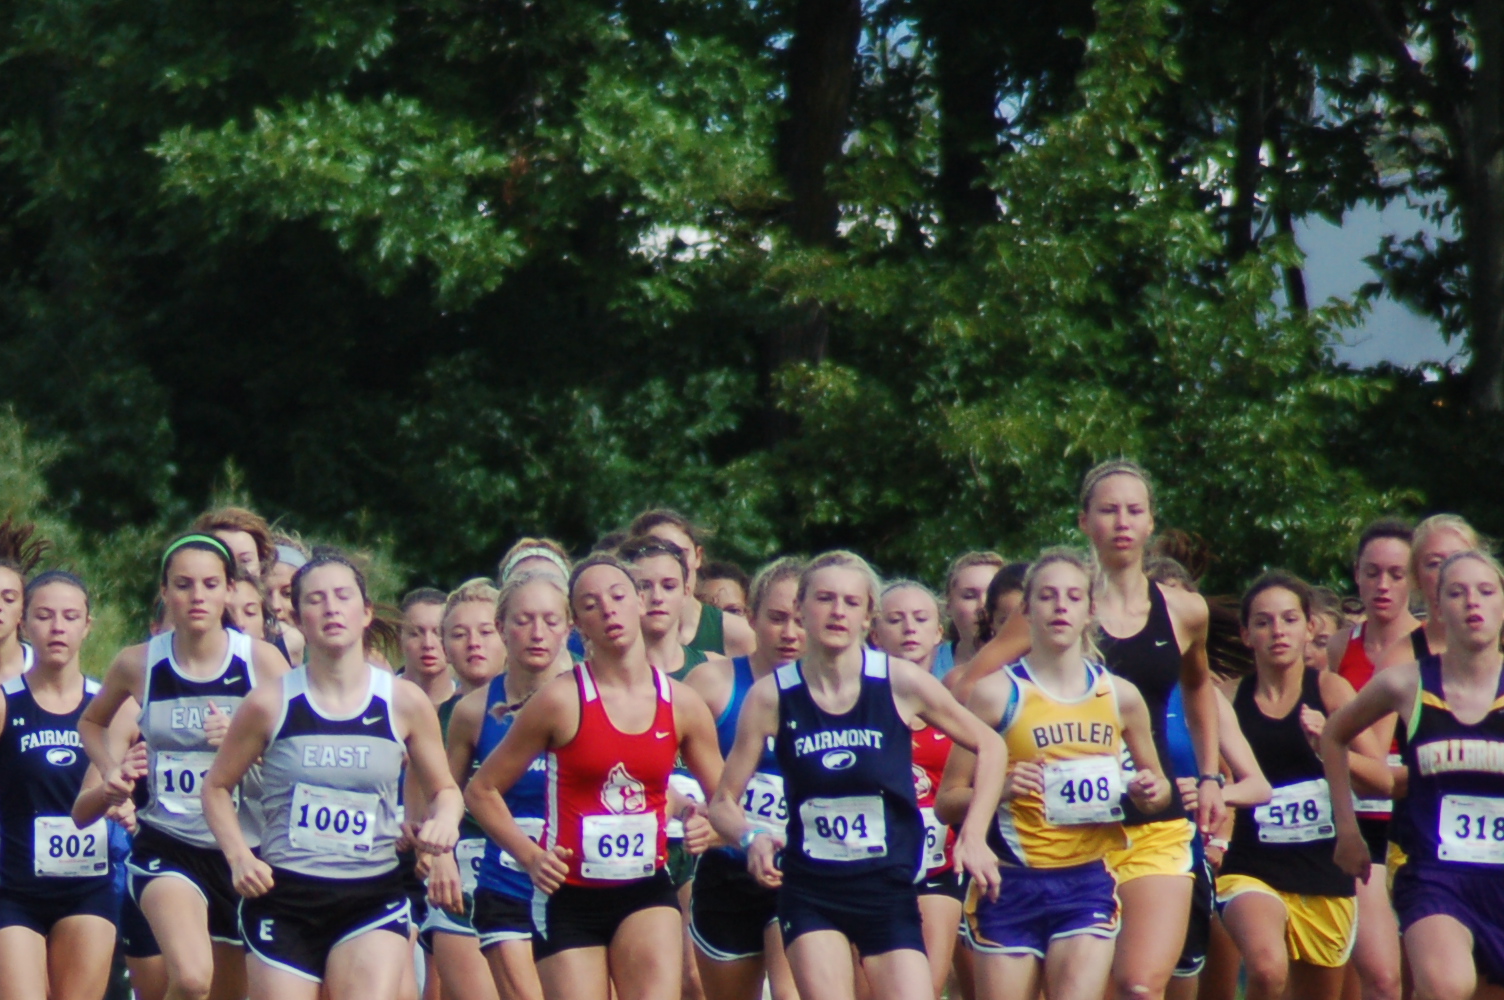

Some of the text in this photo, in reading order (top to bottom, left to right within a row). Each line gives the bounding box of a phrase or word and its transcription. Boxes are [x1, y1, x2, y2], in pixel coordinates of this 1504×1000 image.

[21, 729, 84, 752] FAIRMO
[794, 729, 883, 757] FAIRMONT
[1033, 721, 1114, 749] BUTLER
[302, 745, 370, 769] EAST
[1059, 776, 1110, 804] 408
[297, 803, 368, 836] 1009
[1268, 799, 1319, 826] 578
[814, 813, 869, 841] 804
[1454, 813, 1504, 842] 318
[48, 833, 96, 858] 802
[597, 832, 645, 859] 692
[259, 918, 275, 941] E
